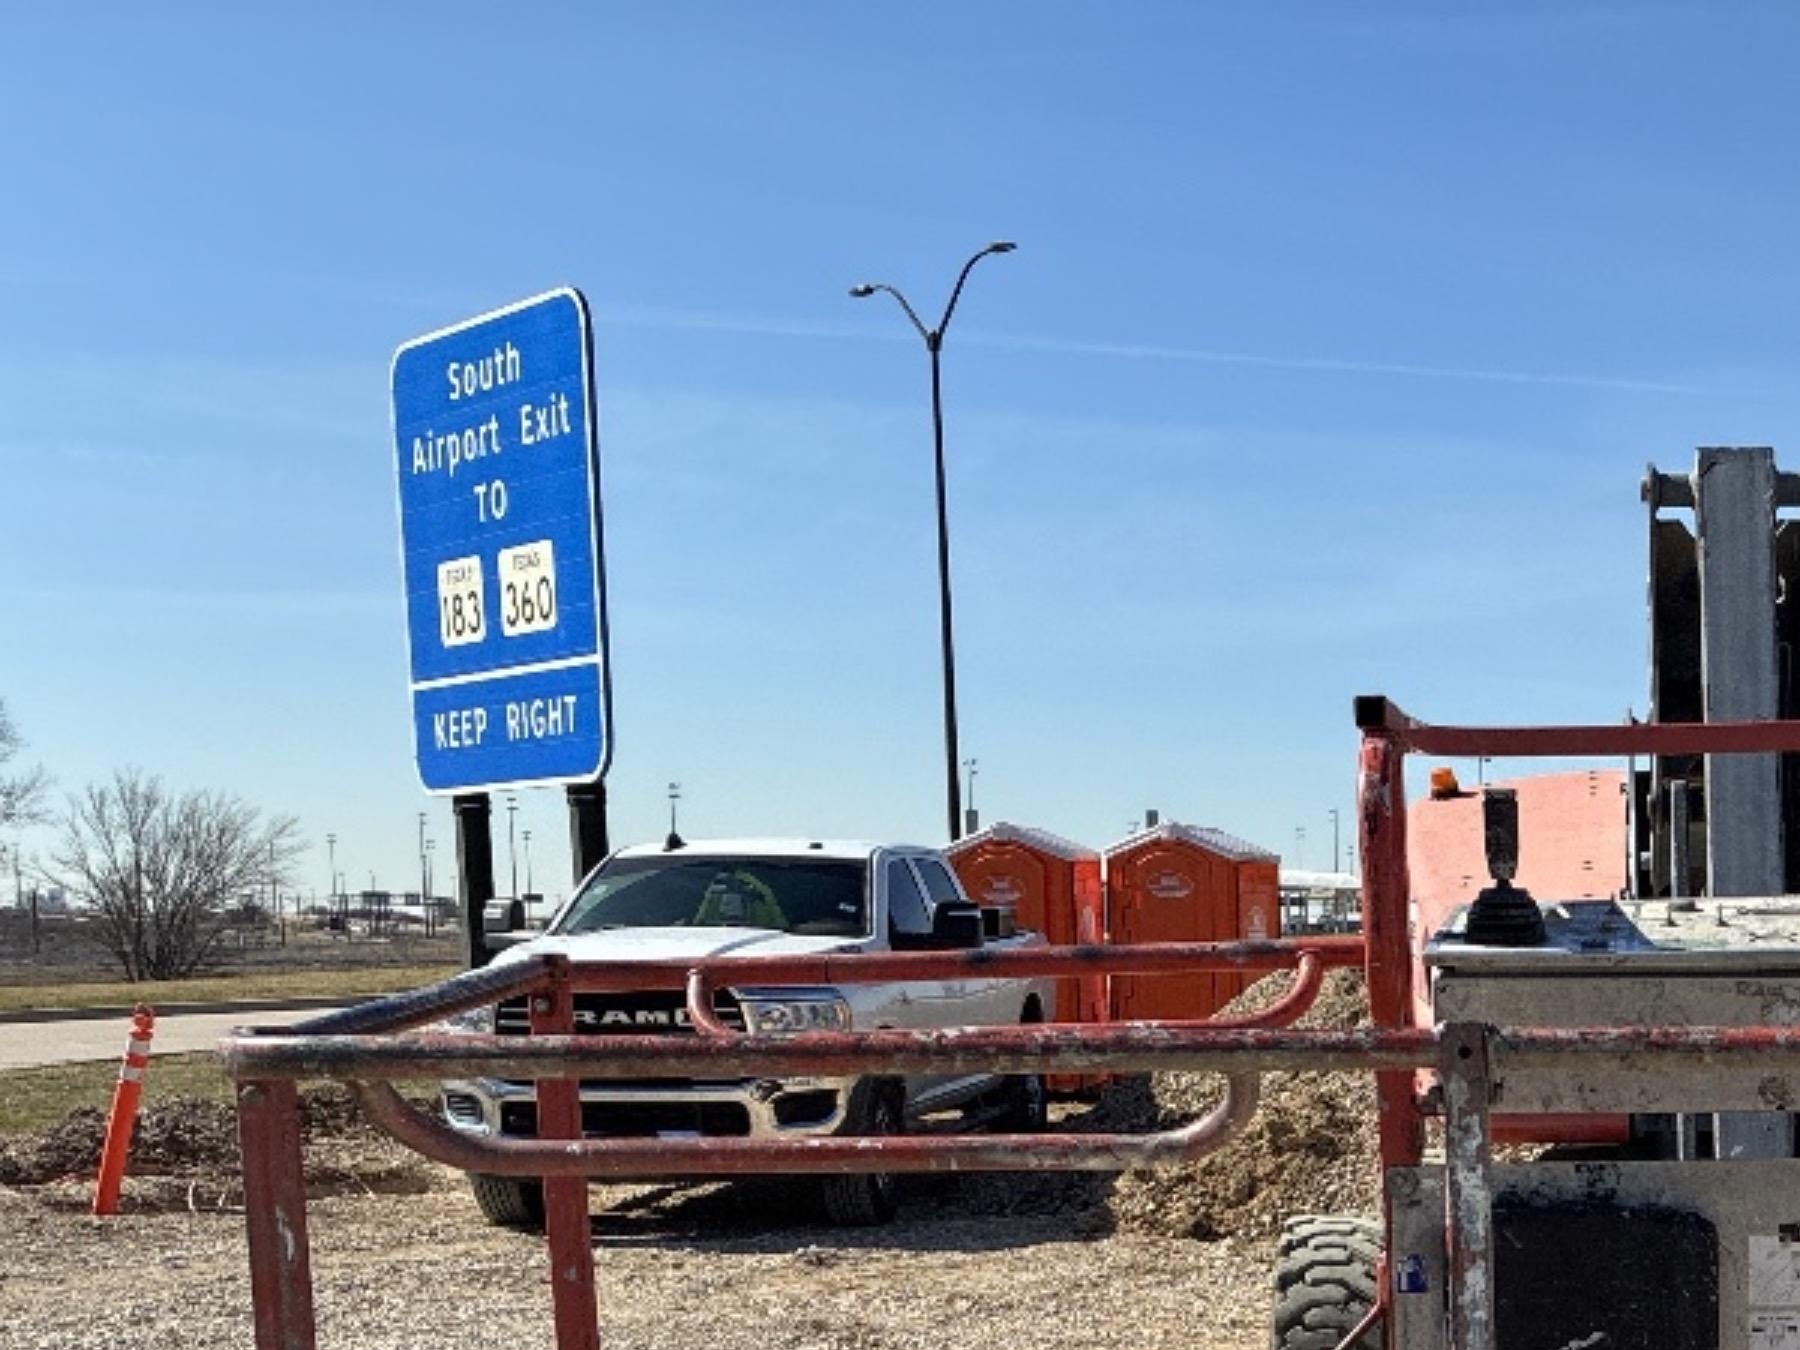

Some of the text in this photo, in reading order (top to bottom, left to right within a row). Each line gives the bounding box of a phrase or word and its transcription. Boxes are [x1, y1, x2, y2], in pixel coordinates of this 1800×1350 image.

[447, 340, 521, 400] South
[412, 391, 571, 478] Airport Exit
[473, 478, 508, 523] TO
[444, 590, 481, 637] 183
[506, 576, 552, 628] 360
[433, 695, 577, 750] KEEP RIGHT
[573, 1009, 670, 1025] RAM
